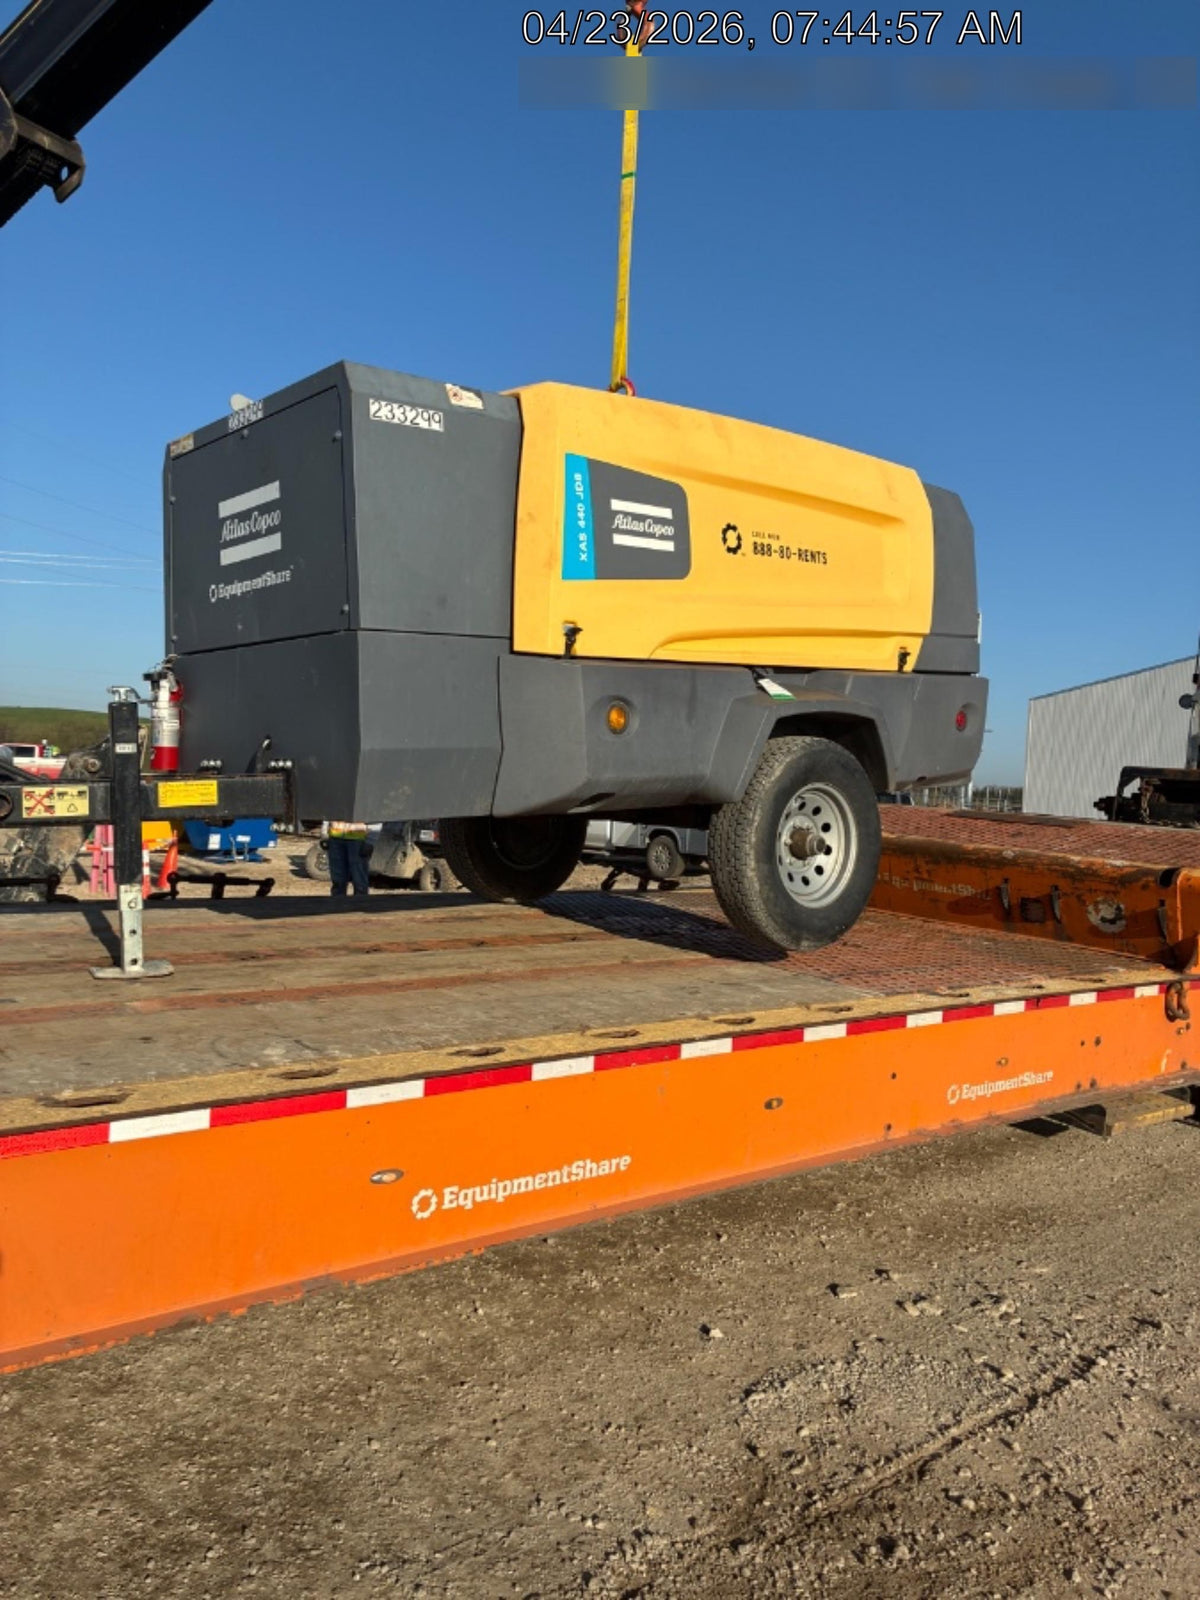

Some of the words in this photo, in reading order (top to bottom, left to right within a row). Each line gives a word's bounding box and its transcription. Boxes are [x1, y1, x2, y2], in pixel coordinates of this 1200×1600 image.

[370, 400, 442, 430] 233299
[577, 503, 586, 529] 440
[578, 532, 588, 562] XAS
[752, 541, 828, 565] 888-80-RENTS
[218, 570, 291, 600] EquipmentShare
[961, 1070, 1054, 1101] EquipmentShare
[442, 1155, 631, 1210] EquipmentShare
